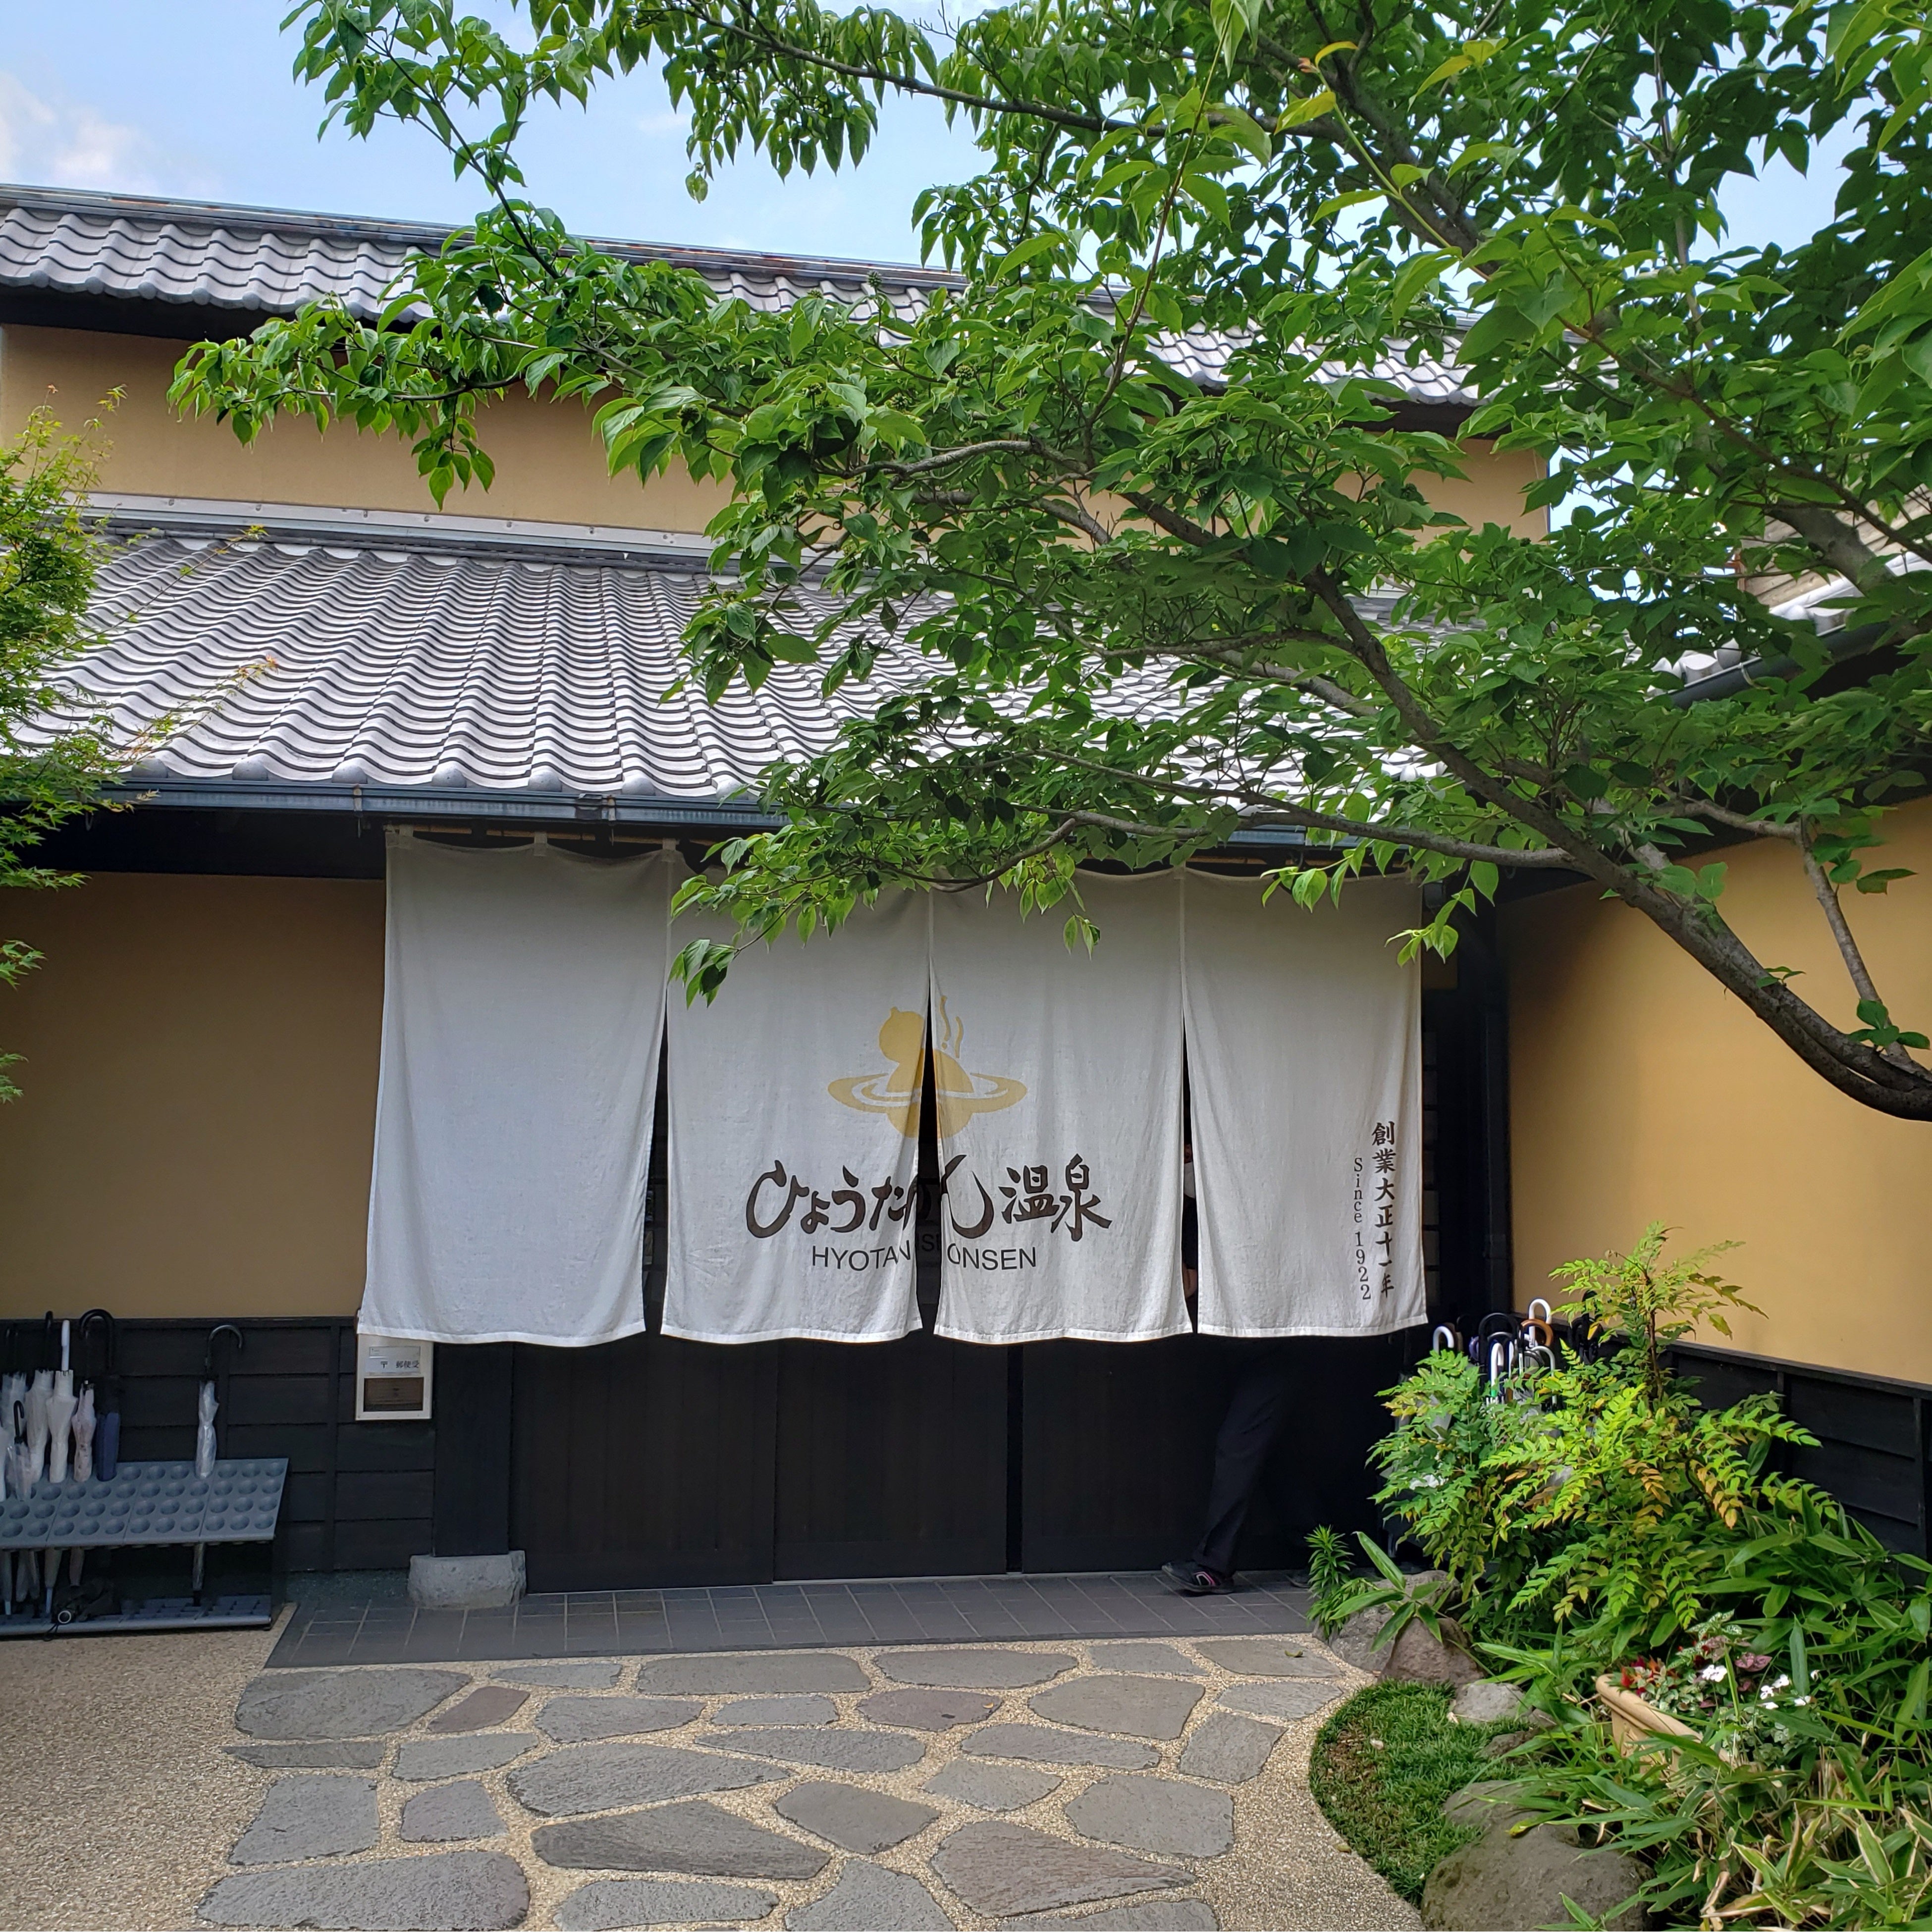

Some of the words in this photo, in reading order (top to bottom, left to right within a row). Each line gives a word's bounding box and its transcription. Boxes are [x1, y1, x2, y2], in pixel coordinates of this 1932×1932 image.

[746, 1154, 1112, 1242] ひょうたん温泉
[1353, 1157, 1363, 1223] Since
[1371, 1121, 1396, 1298] 創業大正十一年
[812, 1240, 911, 1271] HYOTAN
[947, 1243, 1036, 1271] ONSEN
[1354, 1232, 1371, 1300] 1922
